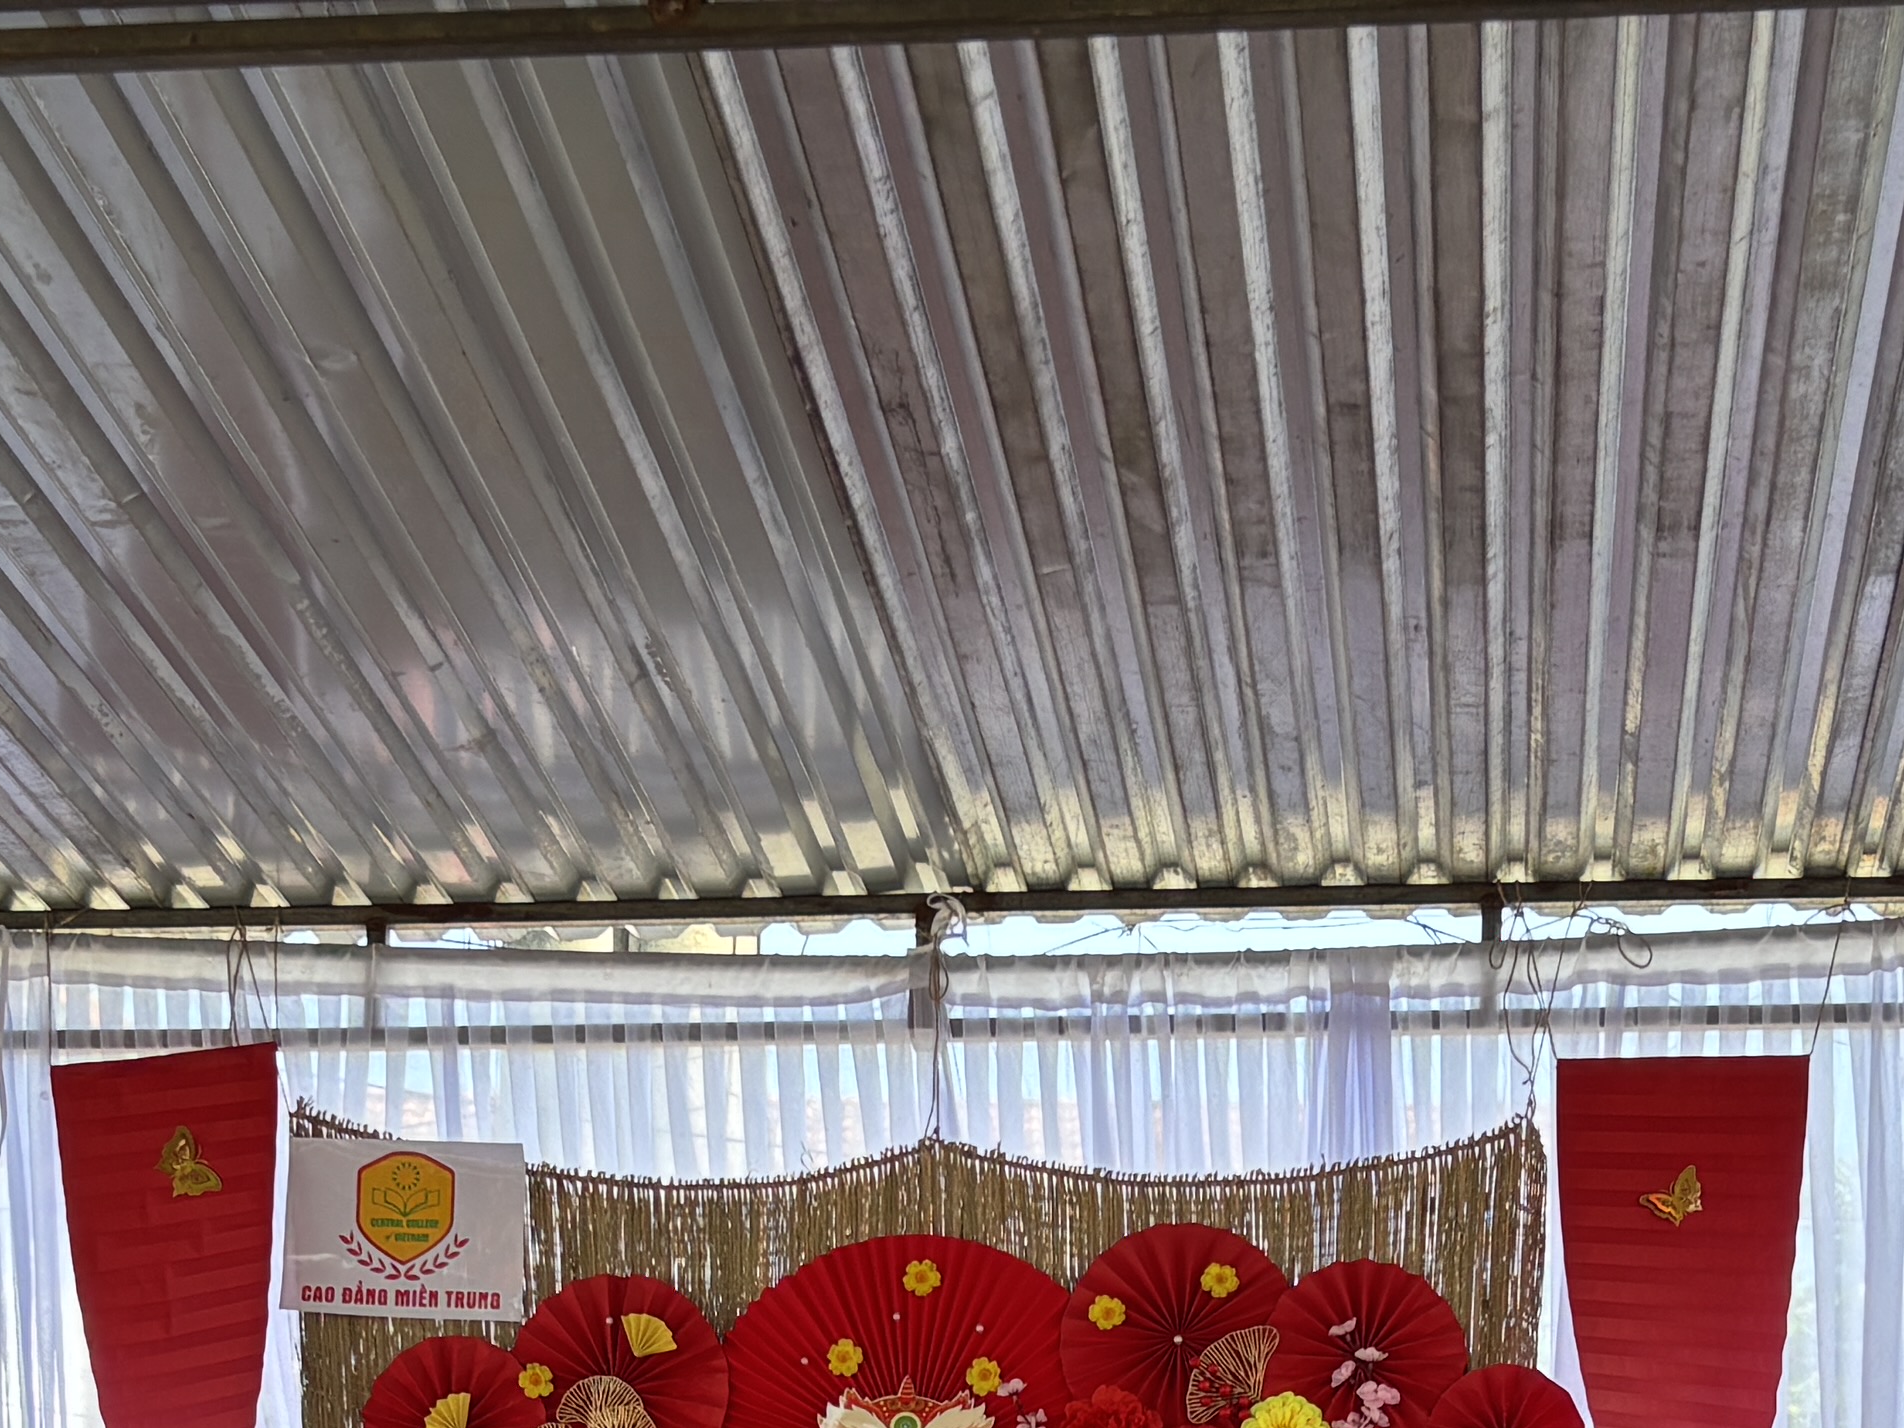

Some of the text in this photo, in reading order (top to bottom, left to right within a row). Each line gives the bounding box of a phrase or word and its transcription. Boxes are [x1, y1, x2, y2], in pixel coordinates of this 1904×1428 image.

[301, 1285, 335, 1303] CAO
[395, 1283, 439, 1308] MIỀN
[445, 1290, 501, 1310] TRUNG
